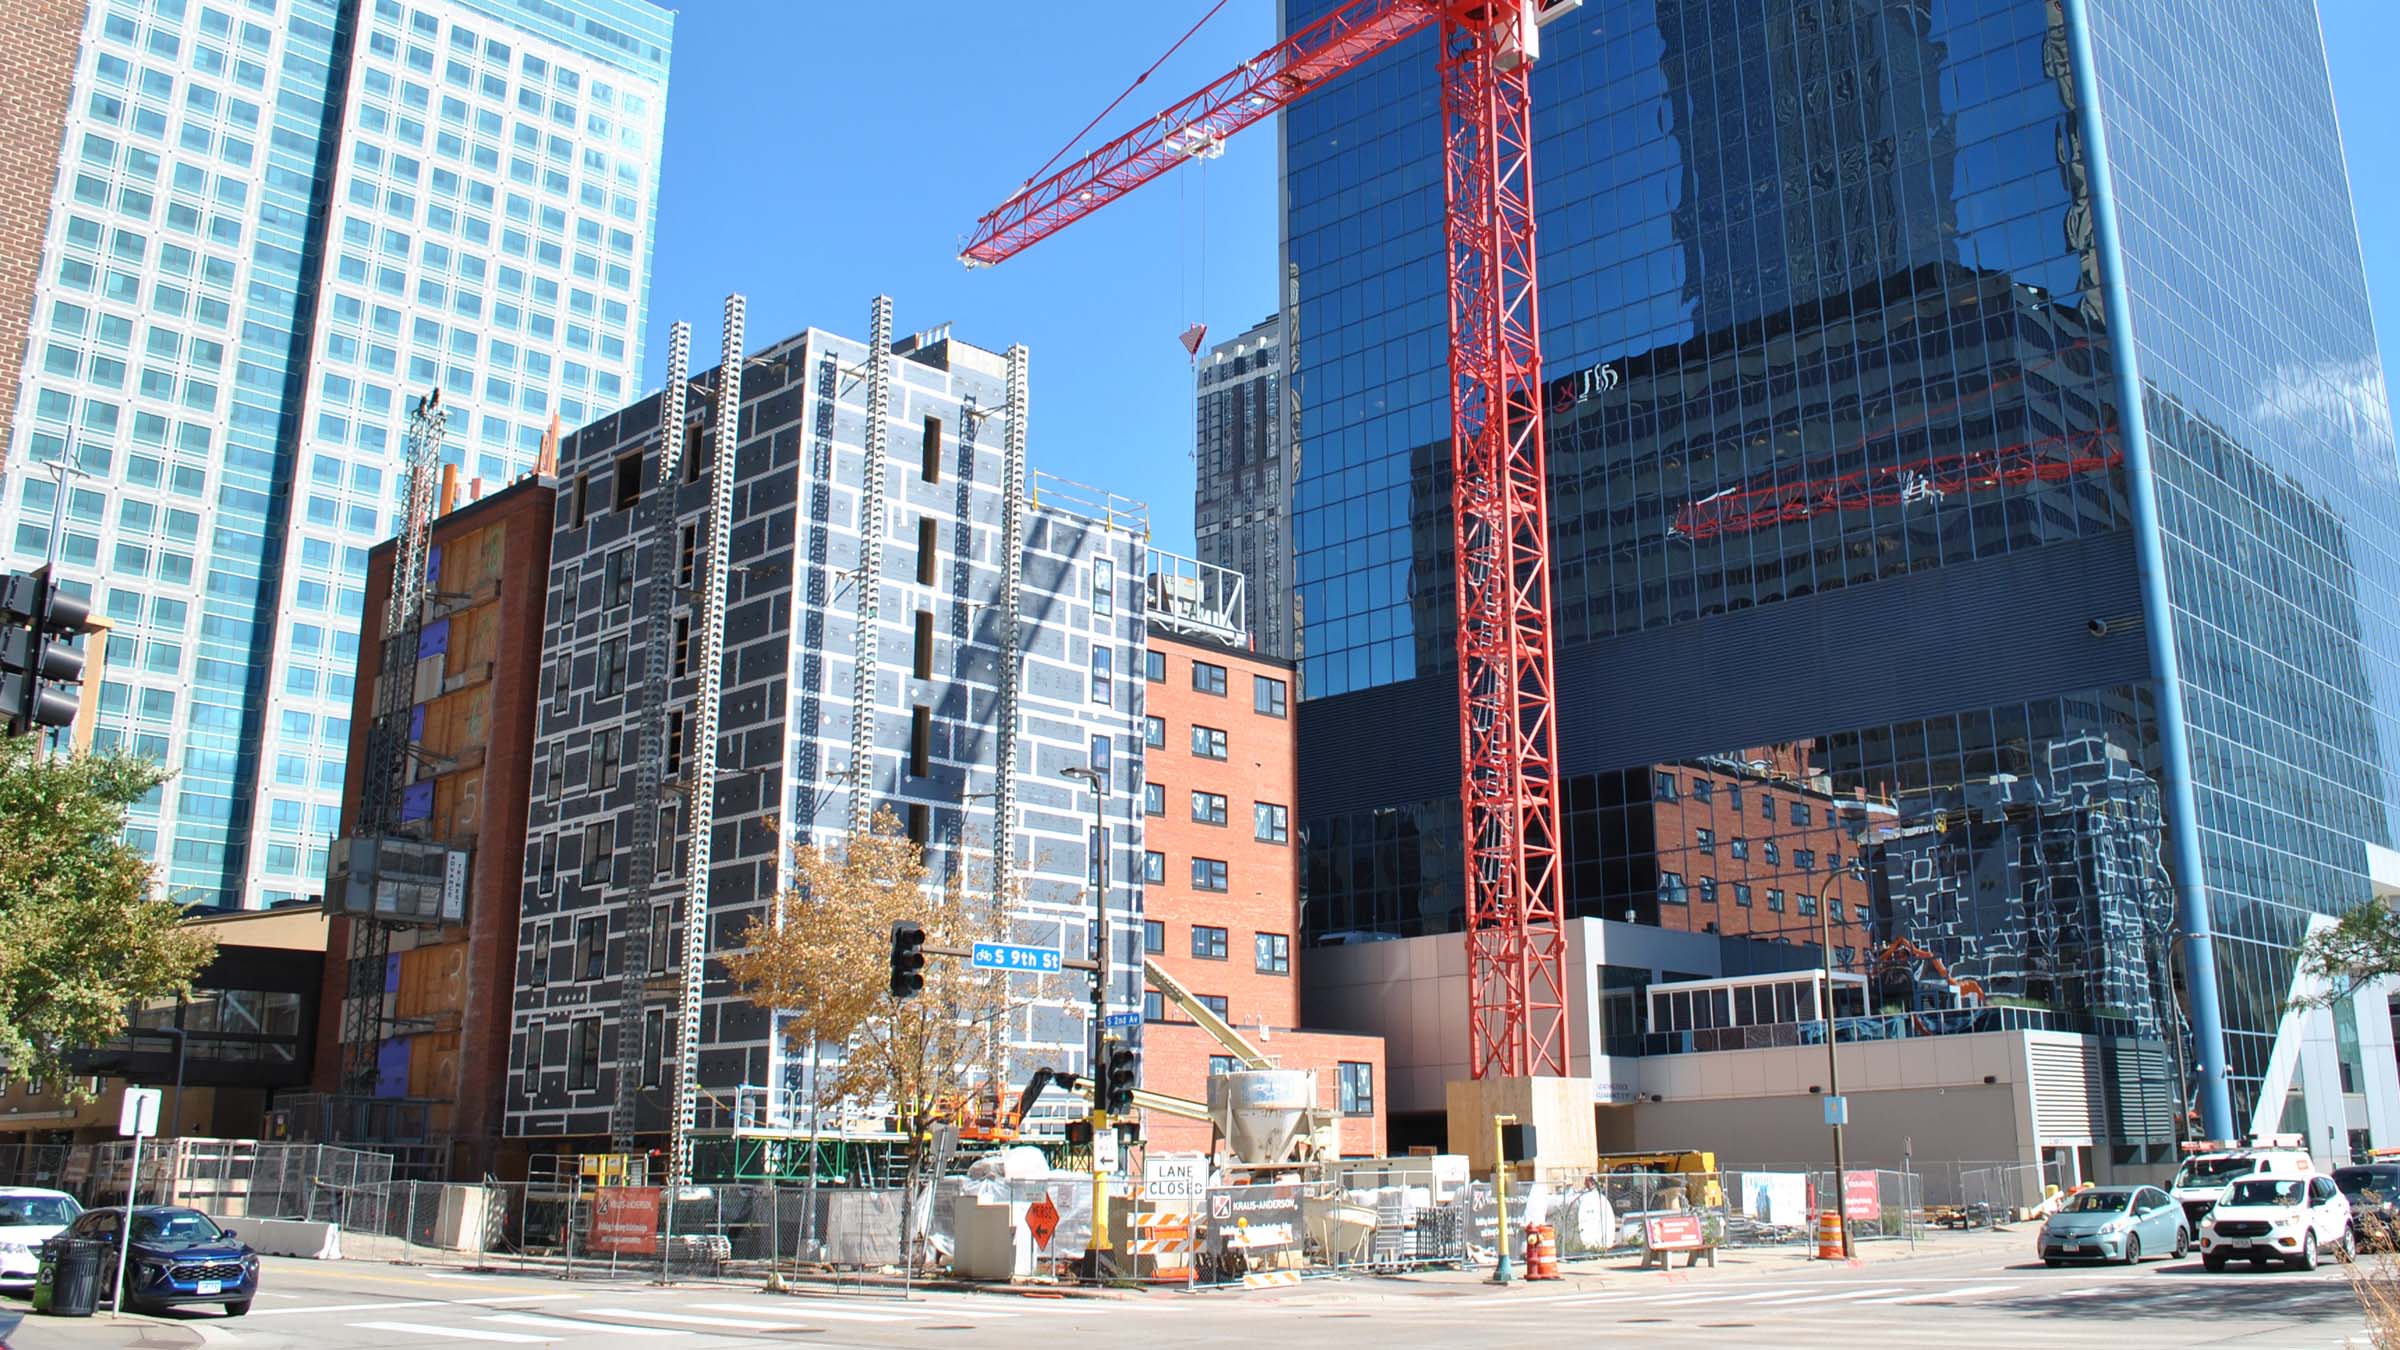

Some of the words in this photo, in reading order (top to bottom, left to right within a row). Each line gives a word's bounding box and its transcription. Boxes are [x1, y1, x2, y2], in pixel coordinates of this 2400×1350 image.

[994, 949, 1004, 964] S
[1011, 950, 1037, 967] 9th
[1042, 954, 1059, 969] St
[1107, 1016, 1112, 1025] S
[1114, 1015, 1127, 1025] 2nd
[1128, 1013, 1139, 1023] Av
[1159, 1165, 1194, 1178] LANE
[1149, 1182, 1203, 1195] CLOSED
[1233, 1199, 1295, 1211] KRAUS-ANDERSON
